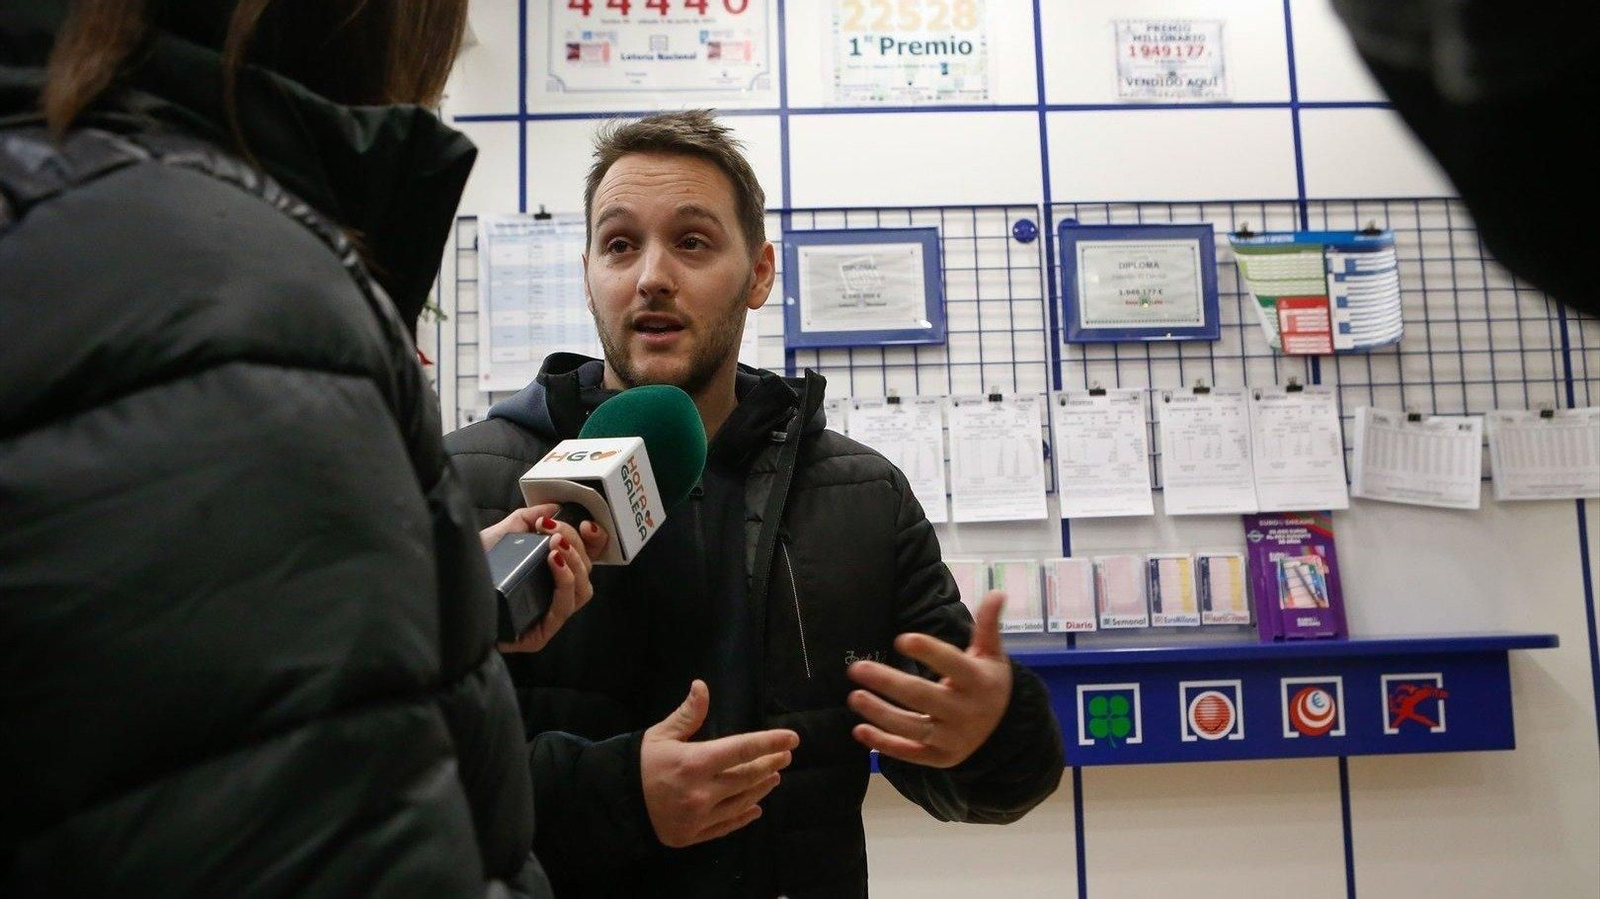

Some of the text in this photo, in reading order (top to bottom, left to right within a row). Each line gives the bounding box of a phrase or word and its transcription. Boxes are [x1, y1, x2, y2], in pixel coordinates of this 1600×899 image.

[880, 36, 973, 56] Premio
[1118, 261, 1160, 270] DIPLOMA
[620, 464, 648, 542] GALEGA
[1065, 621, 1093, 630] Diario
